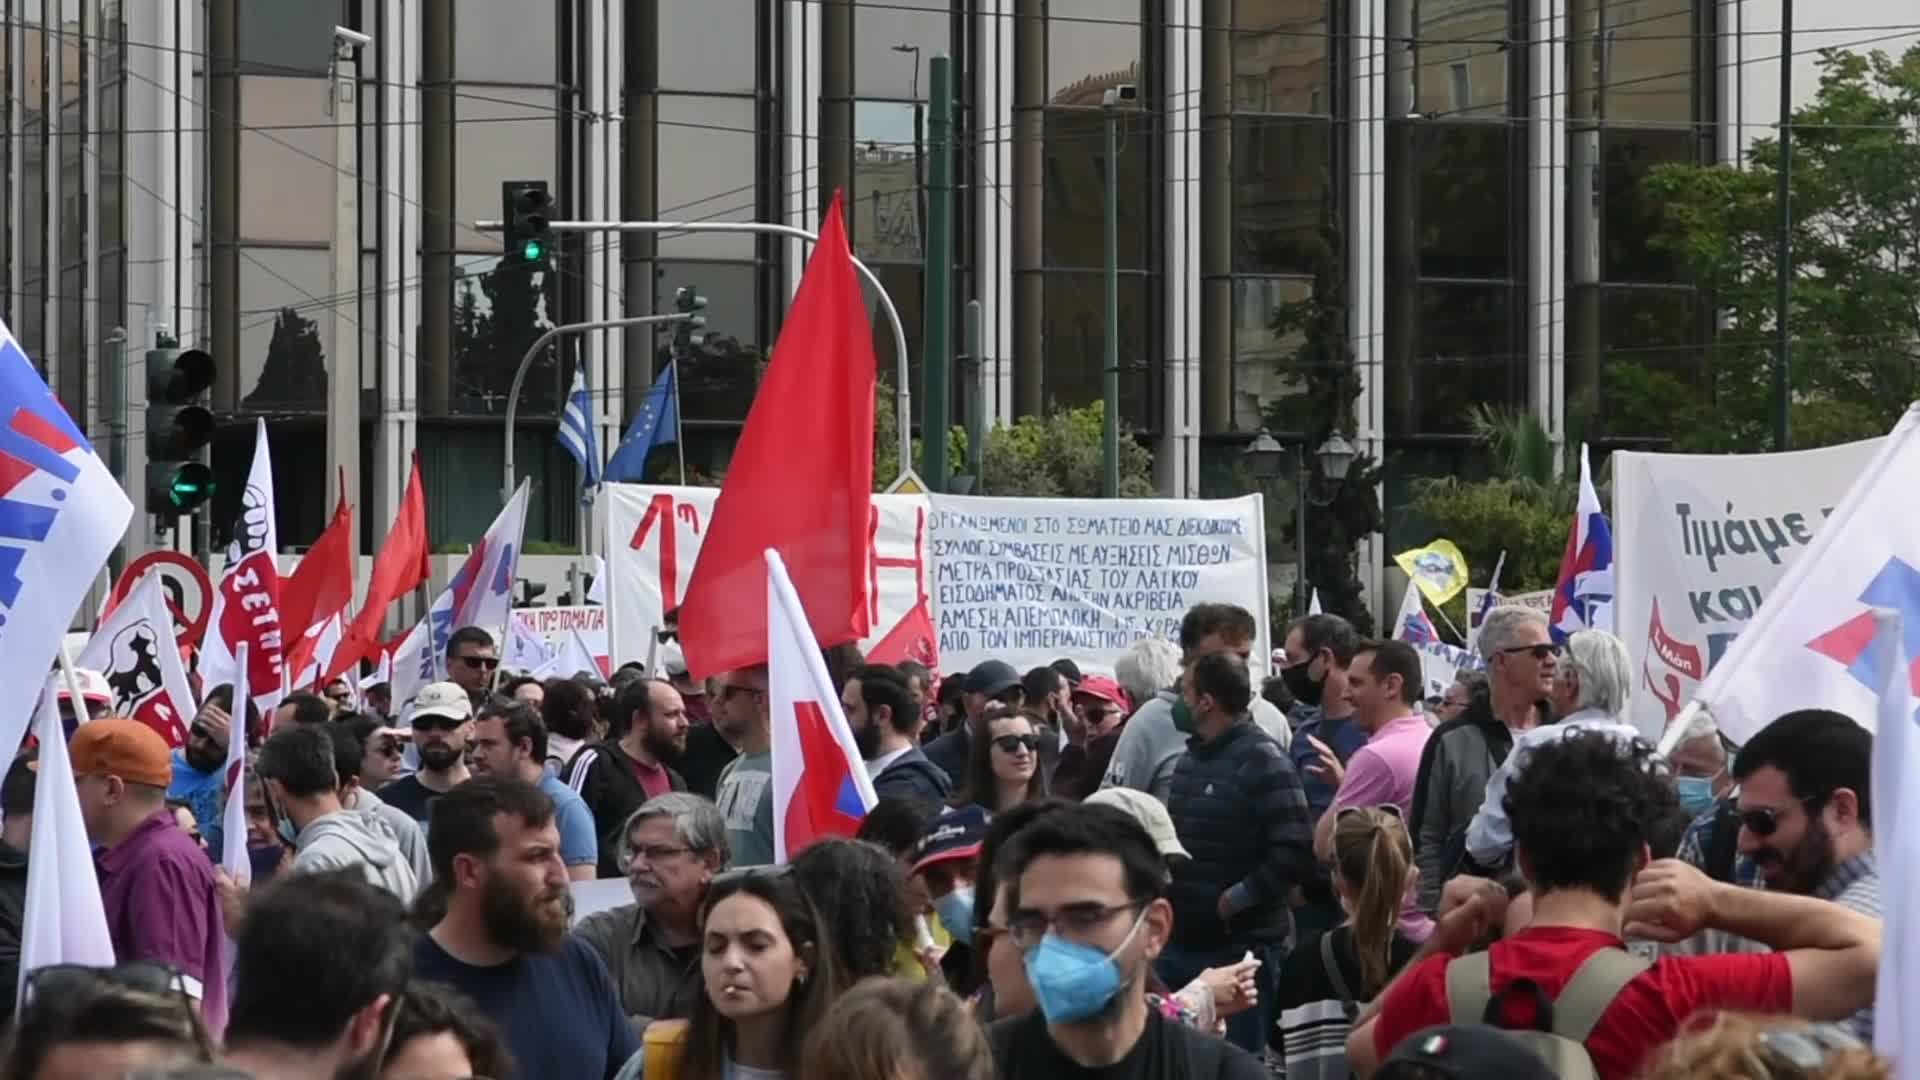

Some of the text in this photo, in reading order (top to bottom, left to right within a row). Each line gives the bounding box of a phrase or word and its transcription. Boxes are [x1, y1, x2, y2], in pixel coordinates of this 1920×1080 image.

[1033, 516, 1060, 535] ΣΤΟ
[1066, 516, 1140, 536] ΣΩΜΑΤΕΙΟ
[1144, 517, 1174, 536] ΜΑΣ
[1675, 500, 1813, 572] Τιμάμε
[1069, 543, 1090, 565] ΜΕ
[1092, 543, 1162, 567] ΑΥΞΗΣΕΙΣ
[1167, 544, 1231, 565] ΜΙΣΘΩΝ
[938, 561, 993, 582] ΜΕΤΡΑ
[1101, 569, 1129, 589] ΤΟΥ
[940, 583, 1045, 604] ΕΙΣΟΔΗΜΑΤΟΣ
[1113, 592, 1185, 611] ΑΚΡΙΒΕΙΑ
[940, 607, 999, 629] ΑΜΕΣΗ
[940, 631, 970, 653] ΑΠΟ
[978, 630, 1008, 649] ΤΟΝ
